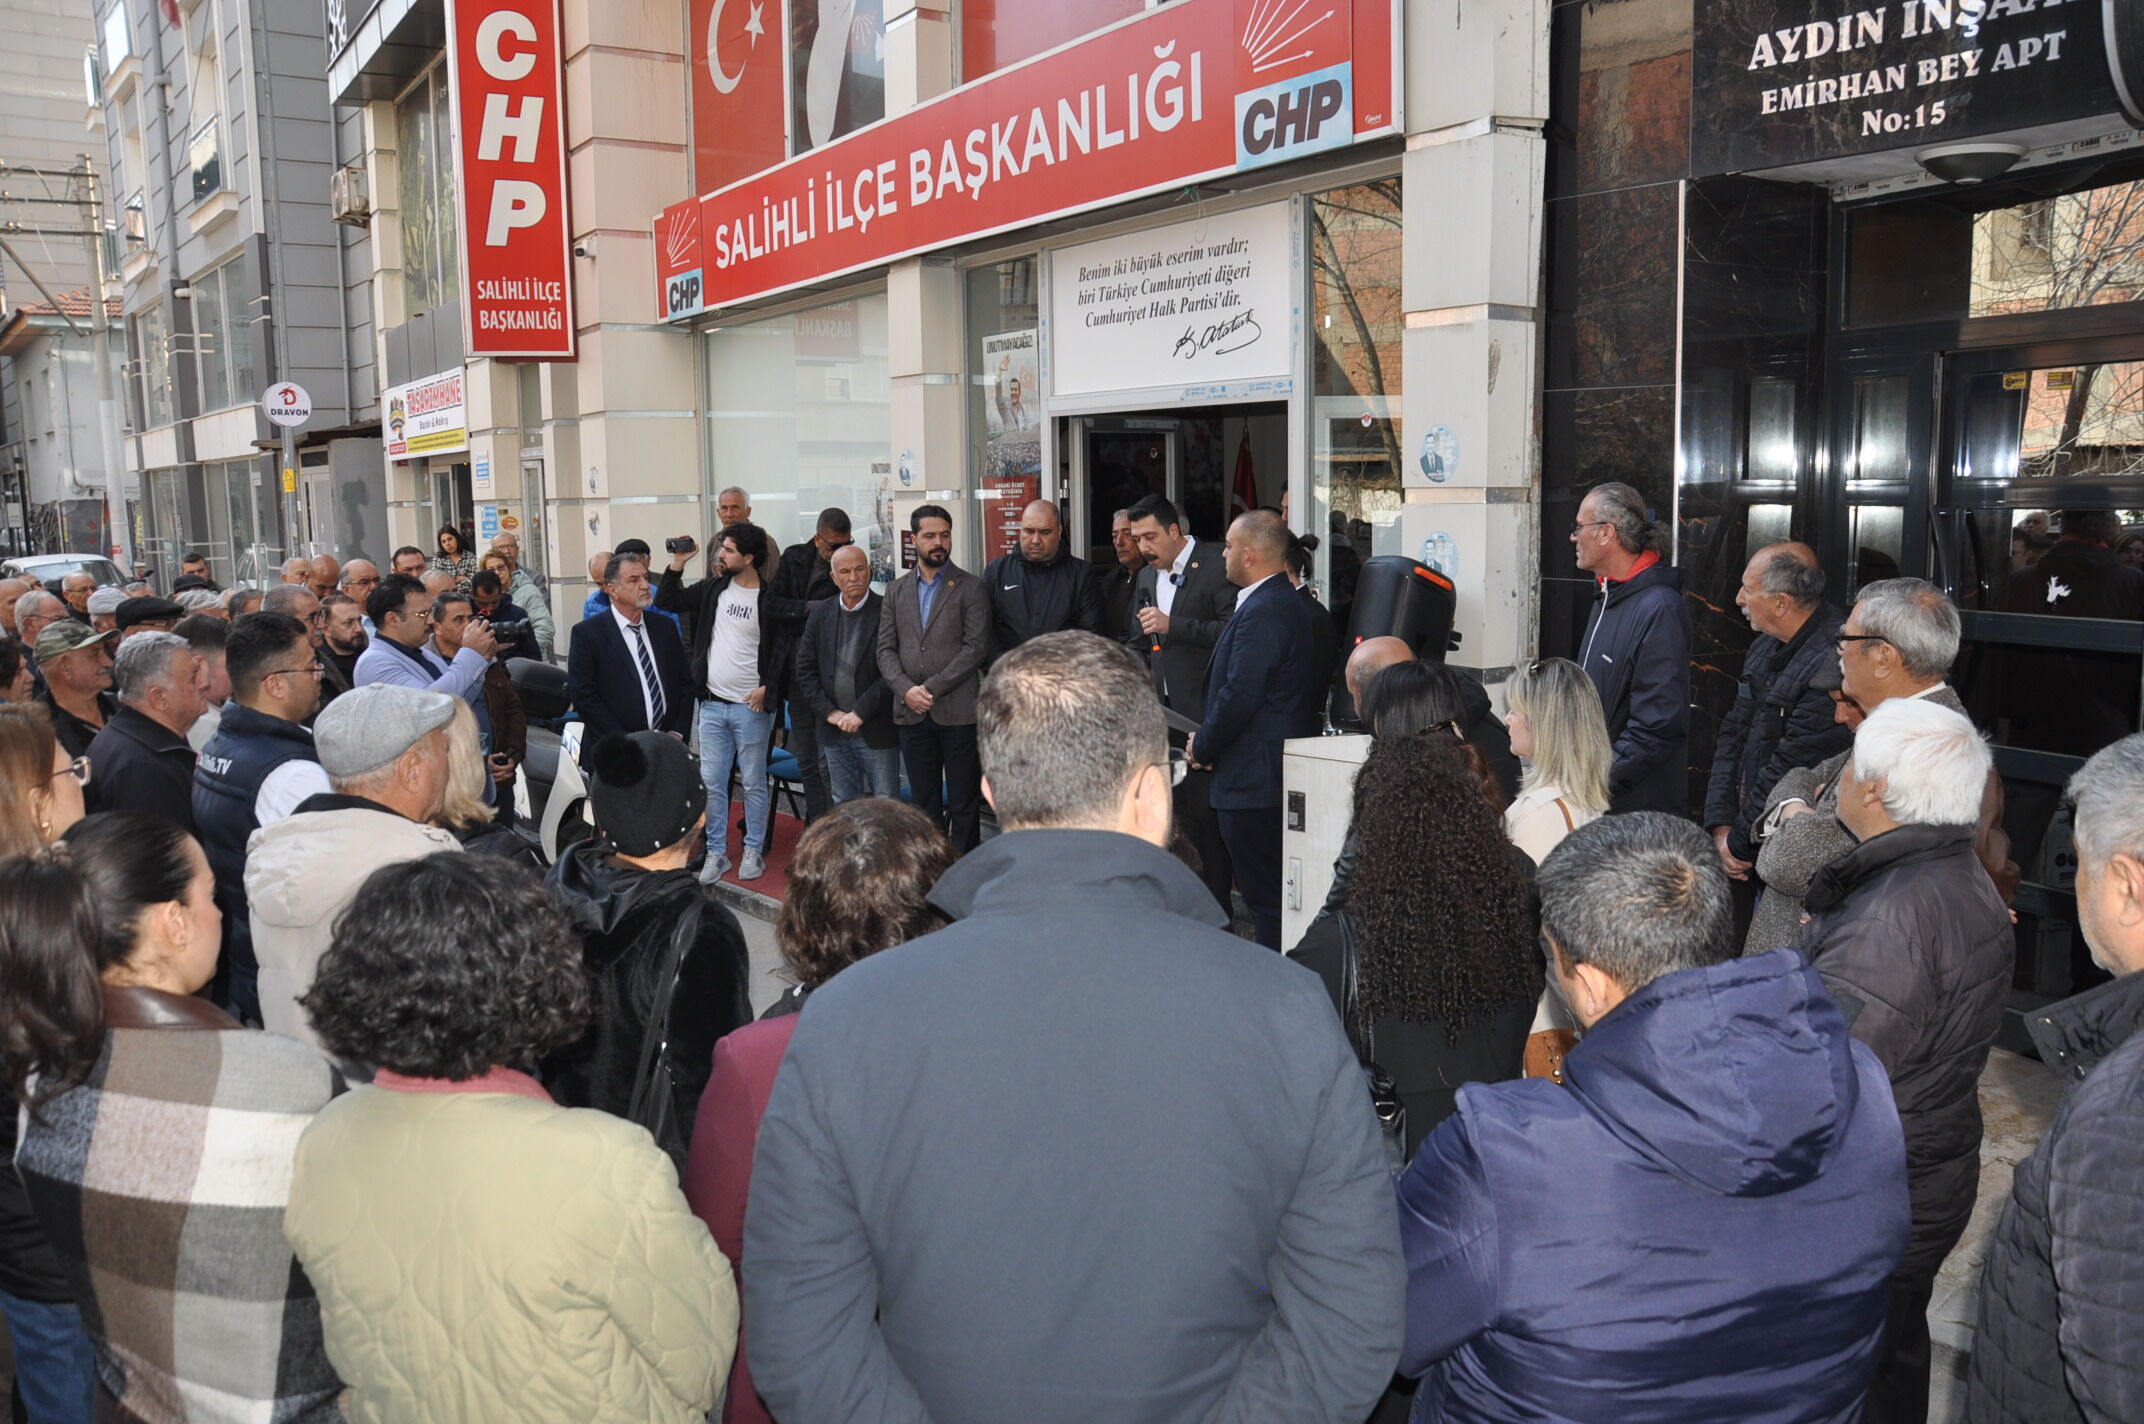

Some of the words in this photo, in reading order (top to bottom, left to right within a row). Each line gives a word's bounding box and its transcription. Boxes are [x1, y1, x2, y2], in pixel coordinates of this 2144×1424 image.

[1747, 7, 1887, 70] AYDIN
[1760, 63, 1908, 115] EMİRHAN
[1917, 49, 1983, 87] BEY
[1990, 31, 2067, 72] APT
[475, 9, 547, 246] CHP
[1242, 79, 1343, 155] CHP
[1861, 100, 1947, 136] No:15
[715, 177, 816, 270] SALİHLİ
[826, 159, 898, 235] İLÇE
[909, 39, 1202, 207] BAŞKANLIĞI
[1078, 263, 1111, 283] Benim
[1113, 259, 1127, 277] iki
[1130, 251, 1163, 276] büyük
[1166, 245, 1204, 266] eserim
[1207, 237, 1249, 257] vardır;
[477, 276, 530, 300] SALİHLİ
[534, 277, 561, 304] İLÇE
[669, 276, 701, 313] CHP
[1078, 288, 1095, 306] biri
[1099, 283, 1138, 305] Türkiye
[1141, 263, 1213, 296] Cumhuriyeti
[1214, 261, 1251, 286] diğeri
[479, 307, 562, 332] BAŞKANLIĞI
[1085, 305, 1147, 328] Cumhuriyet
[1149, 299, 1177, 318] Halk
[1180, 290, 1241, 314] Partisi'dir.
[270, 408, 309, 416] DRAVON
